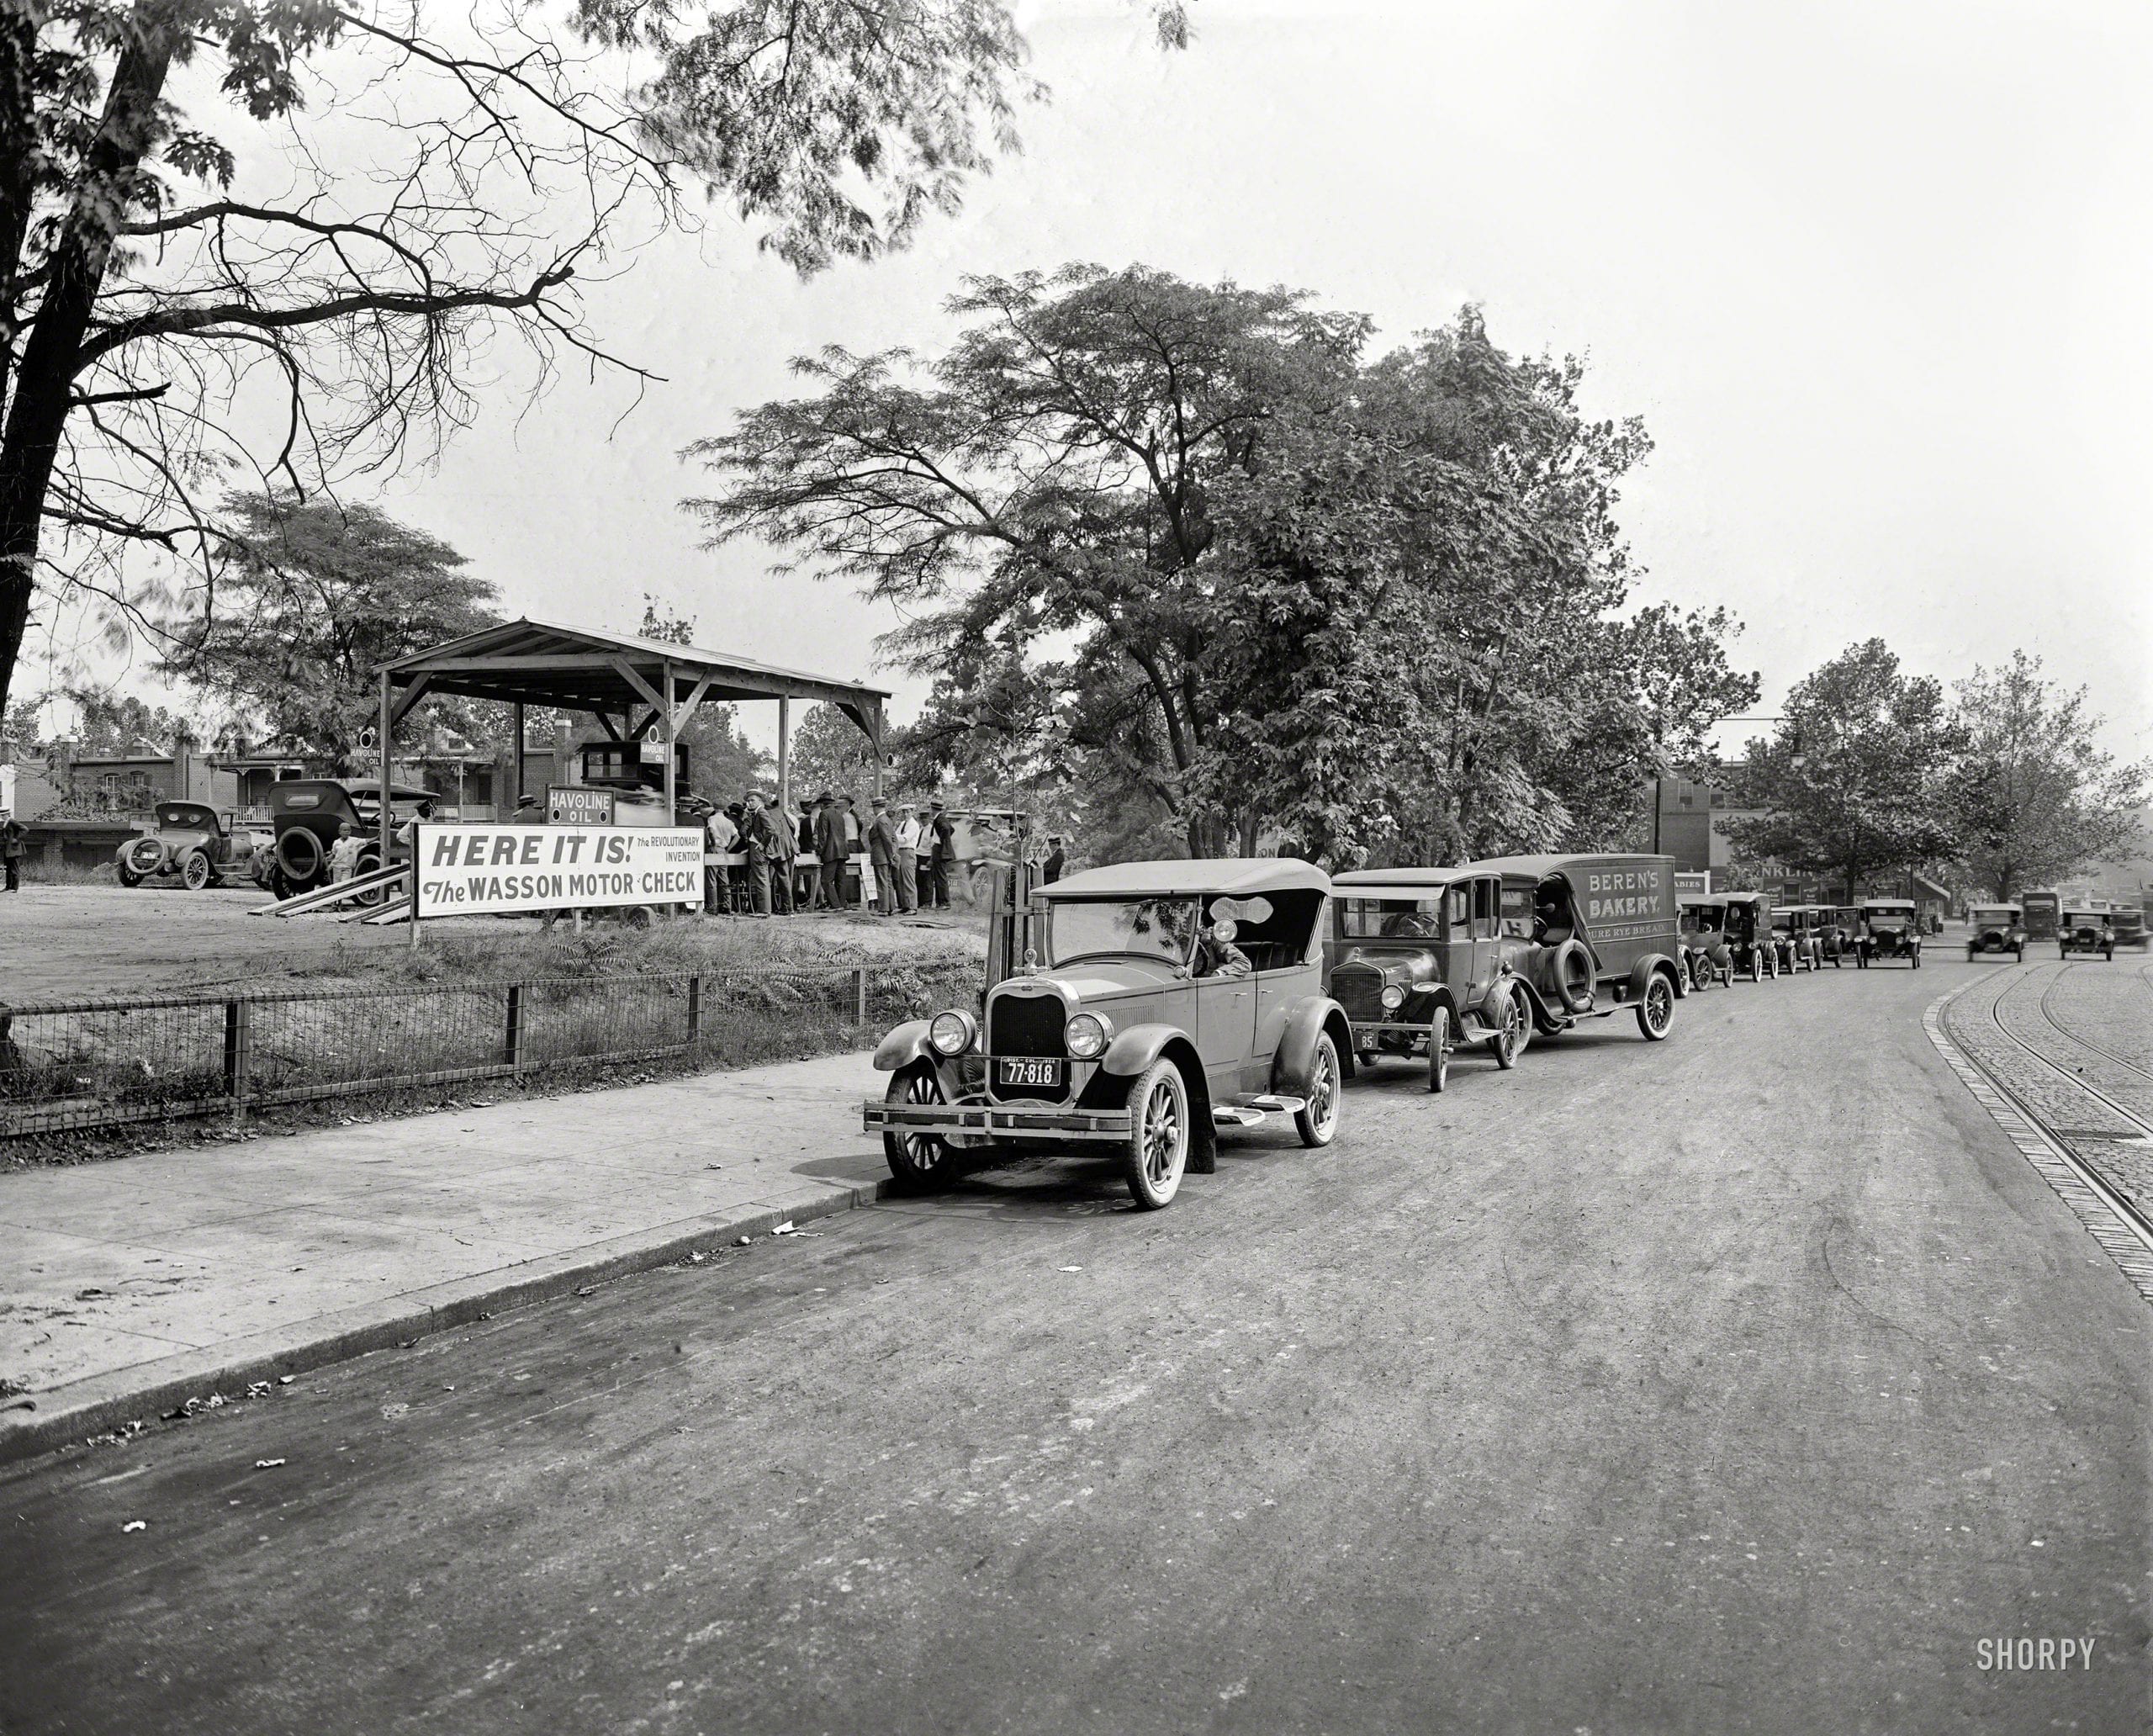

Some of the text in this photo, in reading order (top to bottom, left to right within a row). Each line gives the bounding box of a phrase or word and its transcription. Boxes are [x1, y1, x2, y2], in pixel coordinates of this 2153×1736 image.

[550, 791, 611, 810] HAVOLINE
[569, 811, 592, 823] OIL
[637, 836, 700, 848] The REVOLUTIONARY
[431, 835, 634, 867] HERE IT IS!
[665, 850, 701, 863] INVENTION
[422, 871, 696, 905] The WASSON MOTOR CHECK
[1589, 870, 1659, 892] BEREN'S
[1588, 924, 1665, 939] URE RYE BREAD
